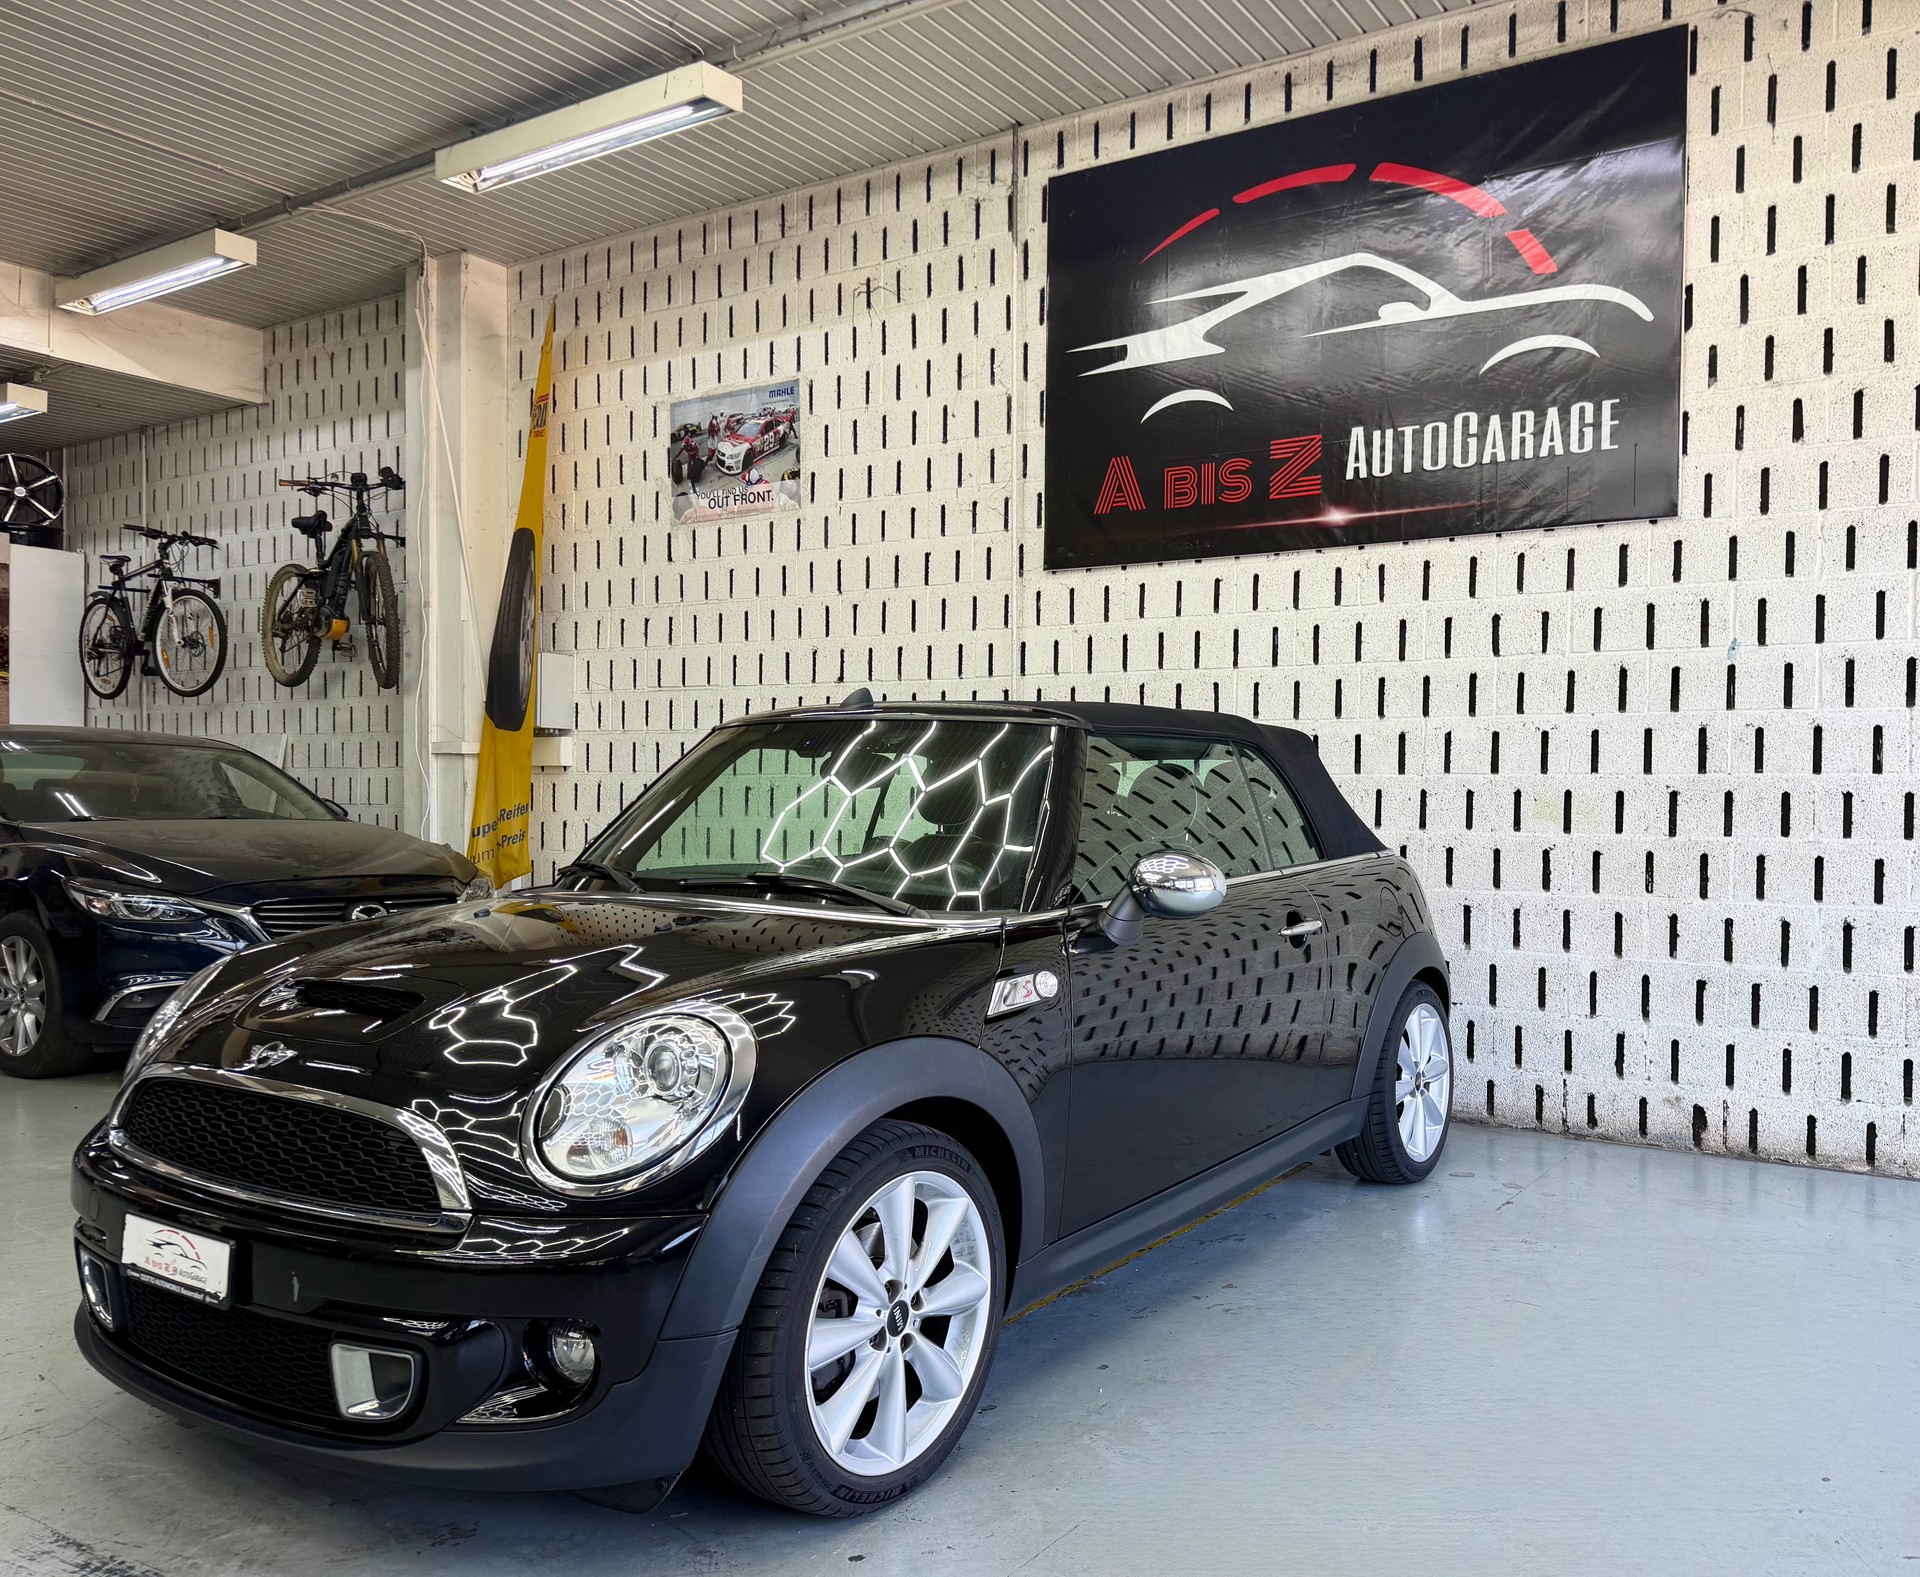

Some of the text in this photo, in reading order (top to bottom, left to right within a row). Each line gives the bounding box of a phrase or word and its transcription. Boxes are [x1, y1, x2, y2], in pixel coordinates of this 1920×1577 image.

[769, 386, 795, 398] MAHLE
[764, 432, 775, 451] 29
[1094, 456, 1146, 515] A
[1164, 458, 1252, 510] BIS
[1269, 435, 1321, 499] Z
[696, 486, 748, 500] YOU'LL FIND US
[708, 490, 774, 509] OUT FRONT.
[914, 1146, 972, 1172] MICHELIN
[893, 1305, 904, 1332] MINI
[836, 1485, 903, 1501] MICHELIN
